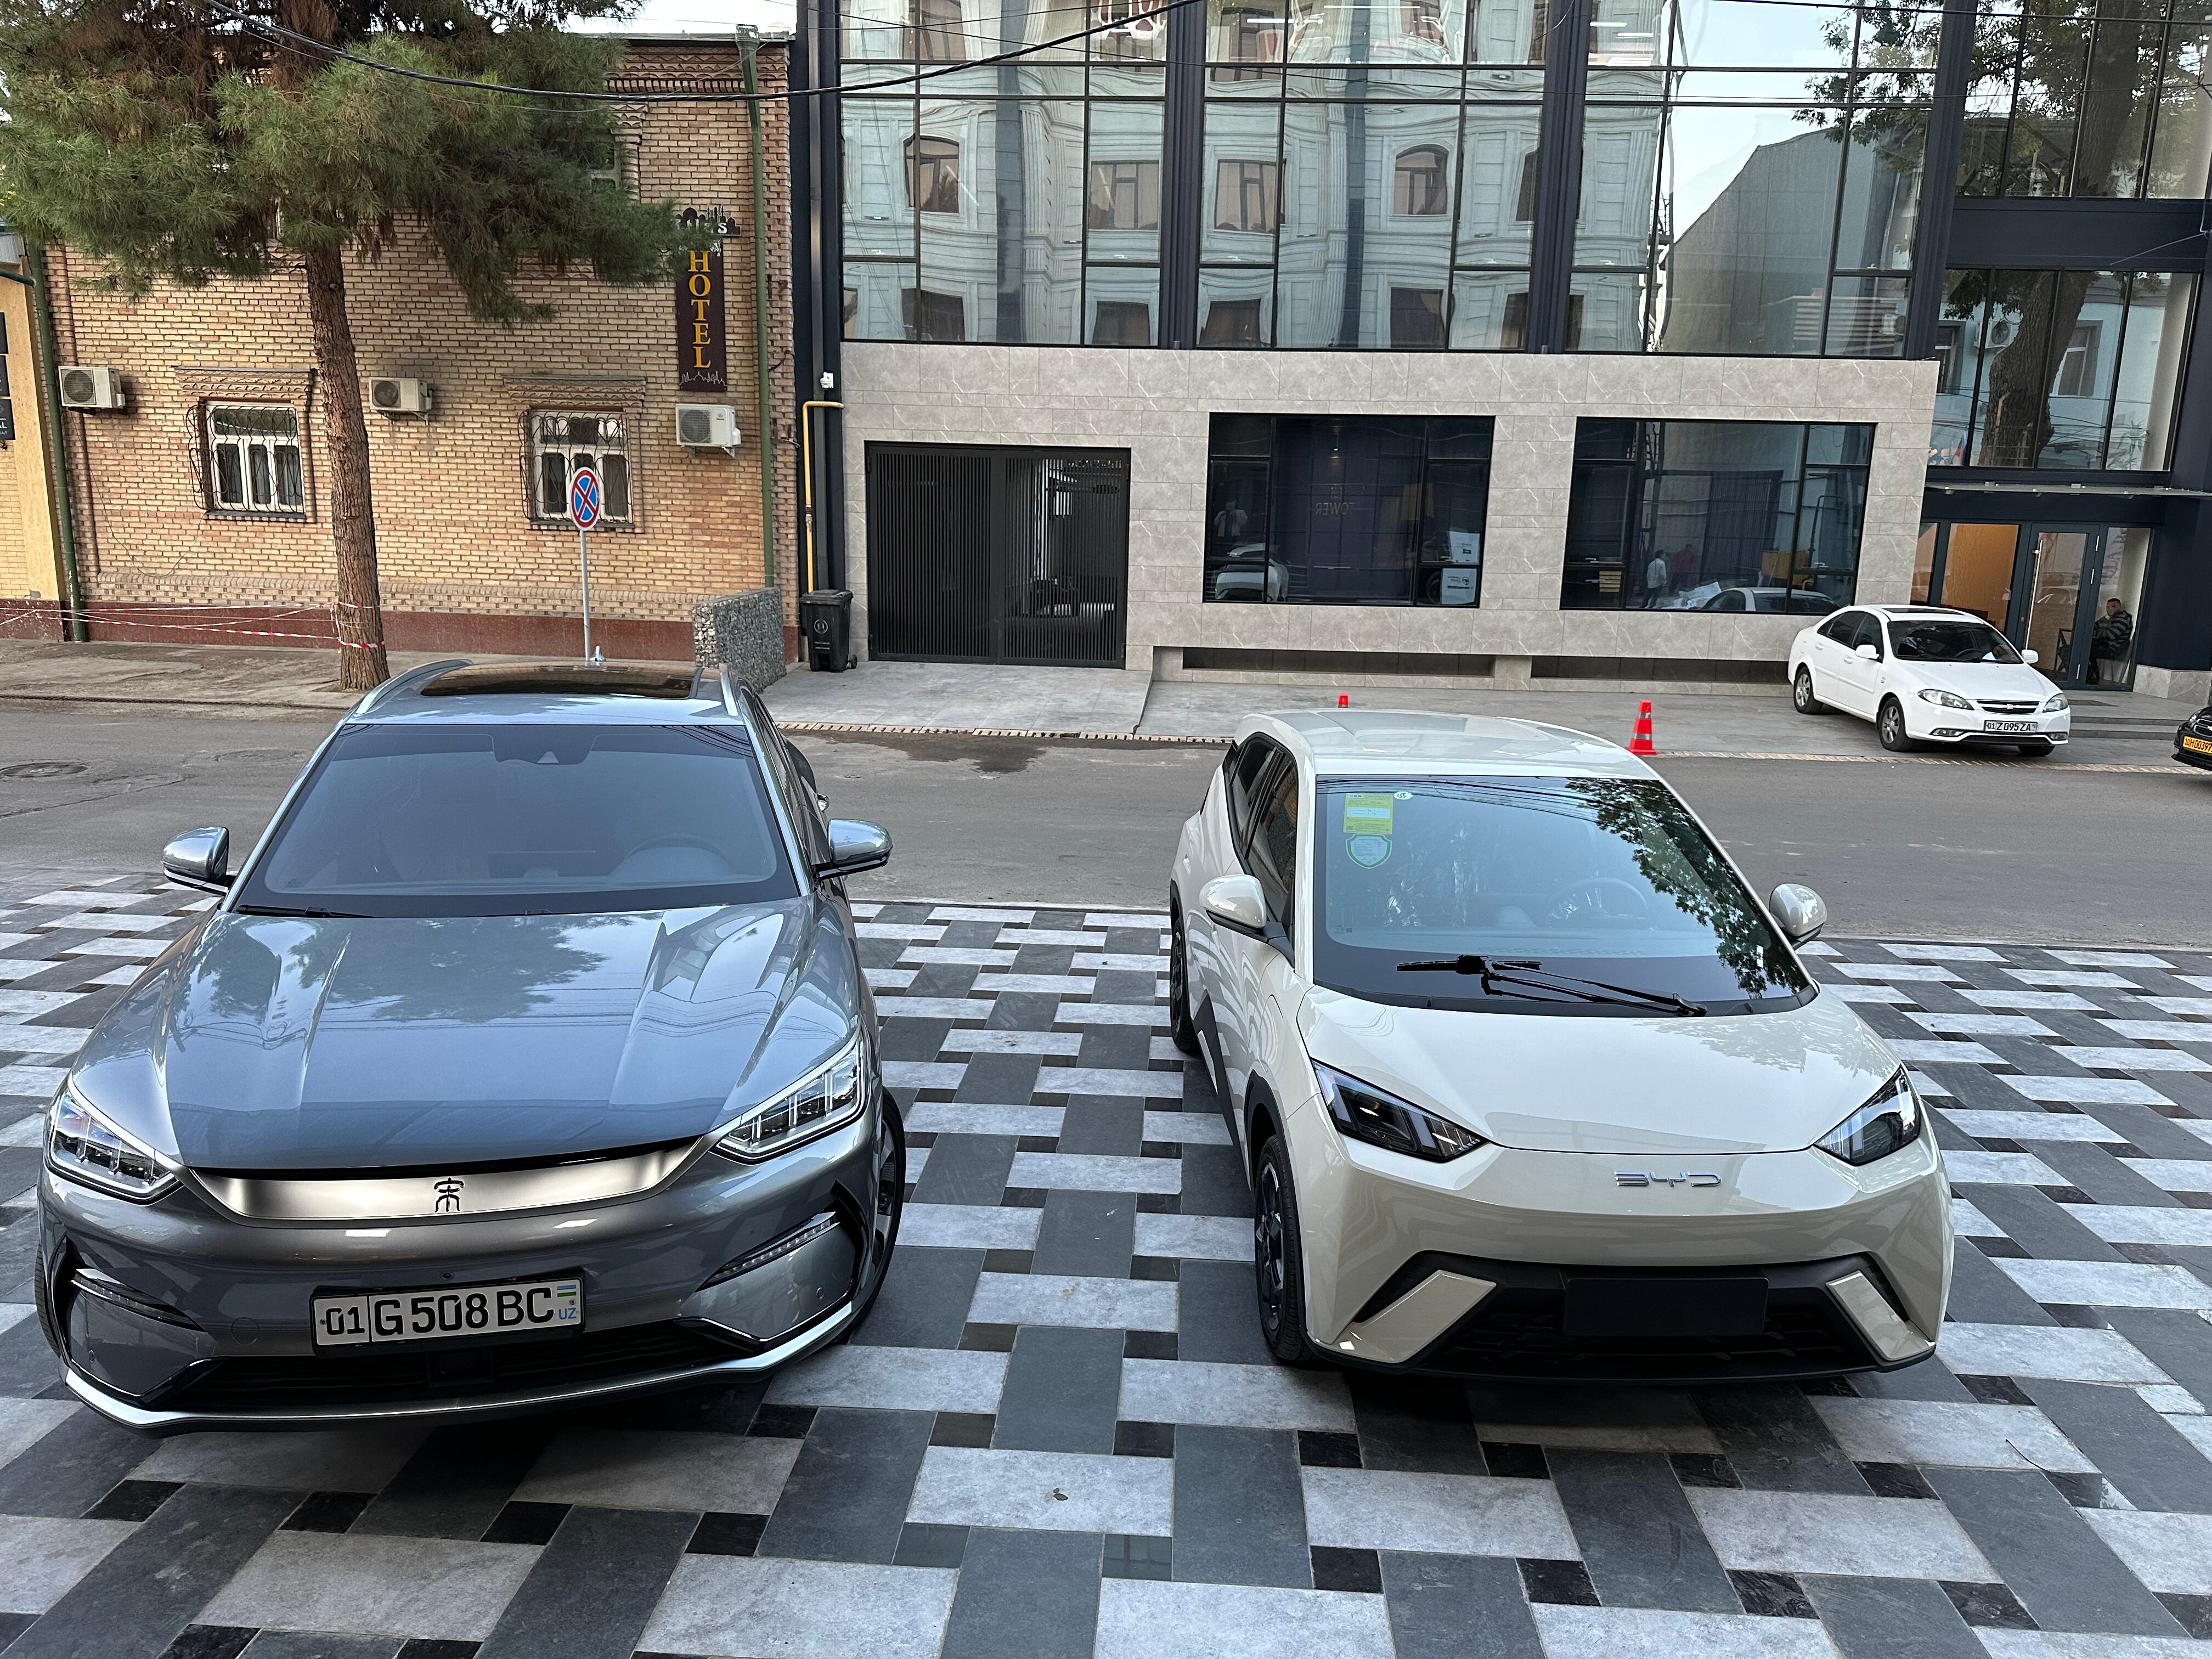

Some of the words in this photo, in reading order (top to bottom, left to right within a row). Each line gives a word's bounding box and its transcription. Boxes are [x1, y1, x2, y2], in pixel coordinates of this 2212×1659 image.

[688, 250, 712, 368] HOTEL
[1996, 722, 2031, 732] Z095ZA
[2189, 738, 2212, 753] H00397
[1613, 1171, 1722, 1187] BYD
[326, 1306, 366, 1335] 01
[374, 1286, 555, 1336] G508BC
[558, 1307, 577, 1321] UZ
